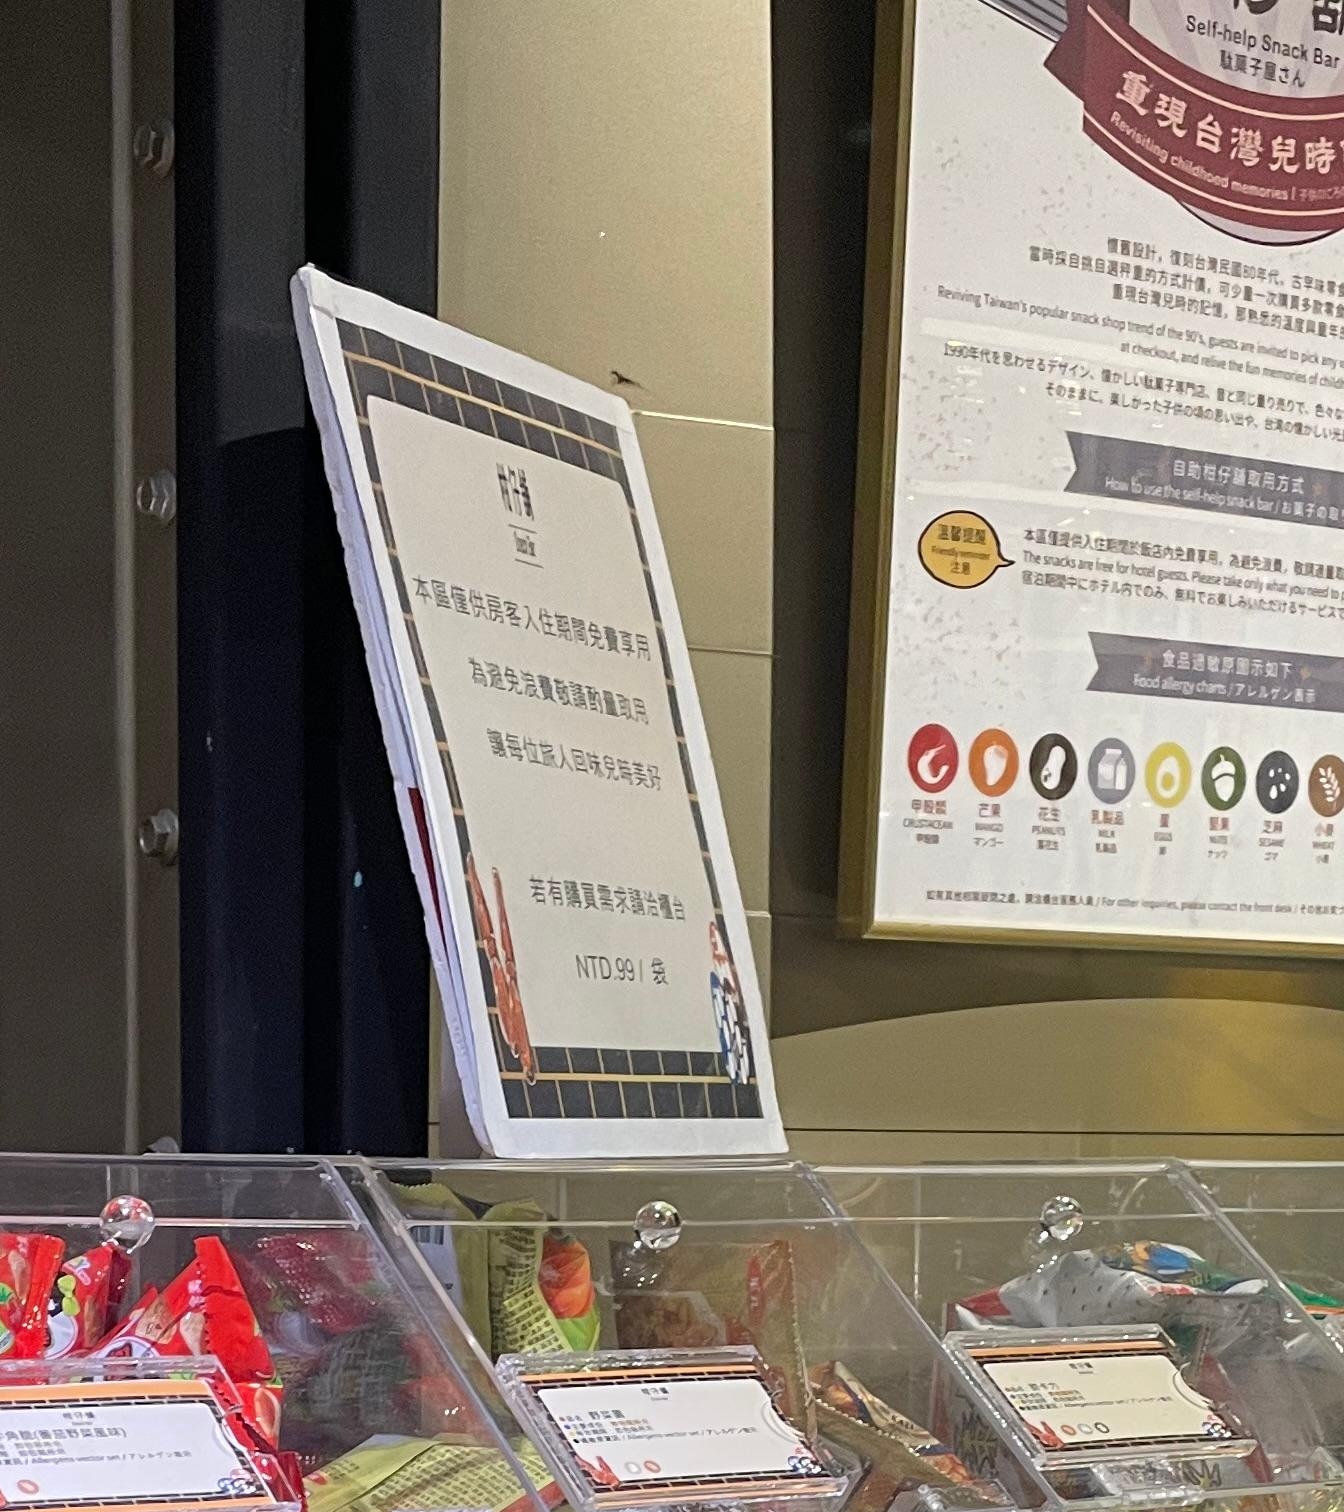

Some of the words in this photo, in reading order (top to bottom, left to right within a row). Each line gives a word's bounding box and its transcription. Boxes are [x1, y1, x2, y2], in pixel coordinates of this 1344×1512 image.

[1187, 15, 1256, 49] Self-help
[1261, 37, 1307, 61] Snack
[1314, 48, 1339, 68] Bar
[1110, 111, 1169, 164] Revisiting
[1171, 156, 1229, 188] childhood
[1232, 181, 1288, 200] memories
[937, 284, 981, 307] Reviving
[984, 292, 1027, 314] Taiwan's
[1029, 301, 1068, 323] popular
[1071, 309, 1098, 326] snack
[1101, 315, 1125, 332] shop
[1127, 319, 1153, 336] trend
[1167, 326, 1182, 341] the
[1208, 334, 1238, 353] guests
[1240, 341, 1254, 354] are
[1290, 348, 1299, 361] to
[1300, 349, 1319, 366] pick
[1321, 354, 1337, 369] any
[1180, 350, 1198, 365] and
[1228, 358, 1242, 372] the
[1262, 363, 1307, 383] memories
[1105, 477, 1127, 491] How
[1129, 480, 1141, 493] to
[1144, 483, 1161, 496] use
[1162, 485, 1180, 499] the
[1257, 496, 1274, 511] bar
[410, 572, 653, 663] 本區僅供房客入住期間免費享用
[466, 655, 649, 726] 為避免浪費敬請酌量取用
[1133, 672, 1160, 689] Food
[1161, 675, 1194, 696] allergy
[485, 726, 662, 791] 讓每位旅人回味兒時美好
[648, 956, 669, 985] 袋
